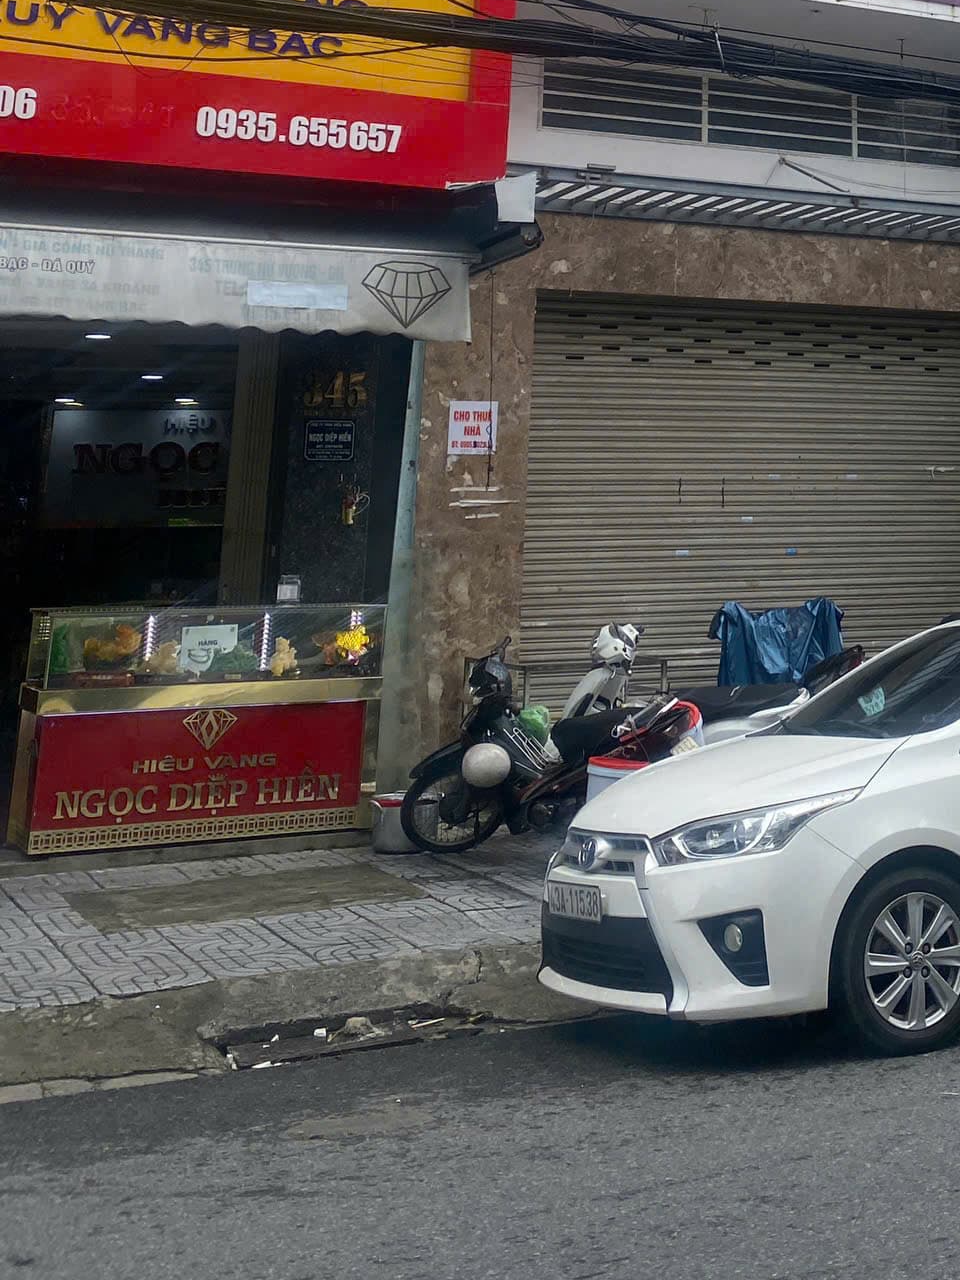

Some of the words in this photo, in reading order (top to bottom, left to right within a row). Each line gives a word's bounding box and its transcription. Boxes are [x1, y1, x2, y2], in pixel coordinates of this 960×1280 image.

[0, 0, 75, 31] UY
[0, 85, 38, 120] 06
[196, 106, 402, 153] 0935.655657
[453, 410, 471, 422] CHO
[464, 424, 481, 436] NHÀ
[204, 752, 277, 771] VÀNG
[53, 783, 158, 824] NGỌC
[167, 774, 248, 816] DIỆP
[256, 761, 343, 806] HIỀN
